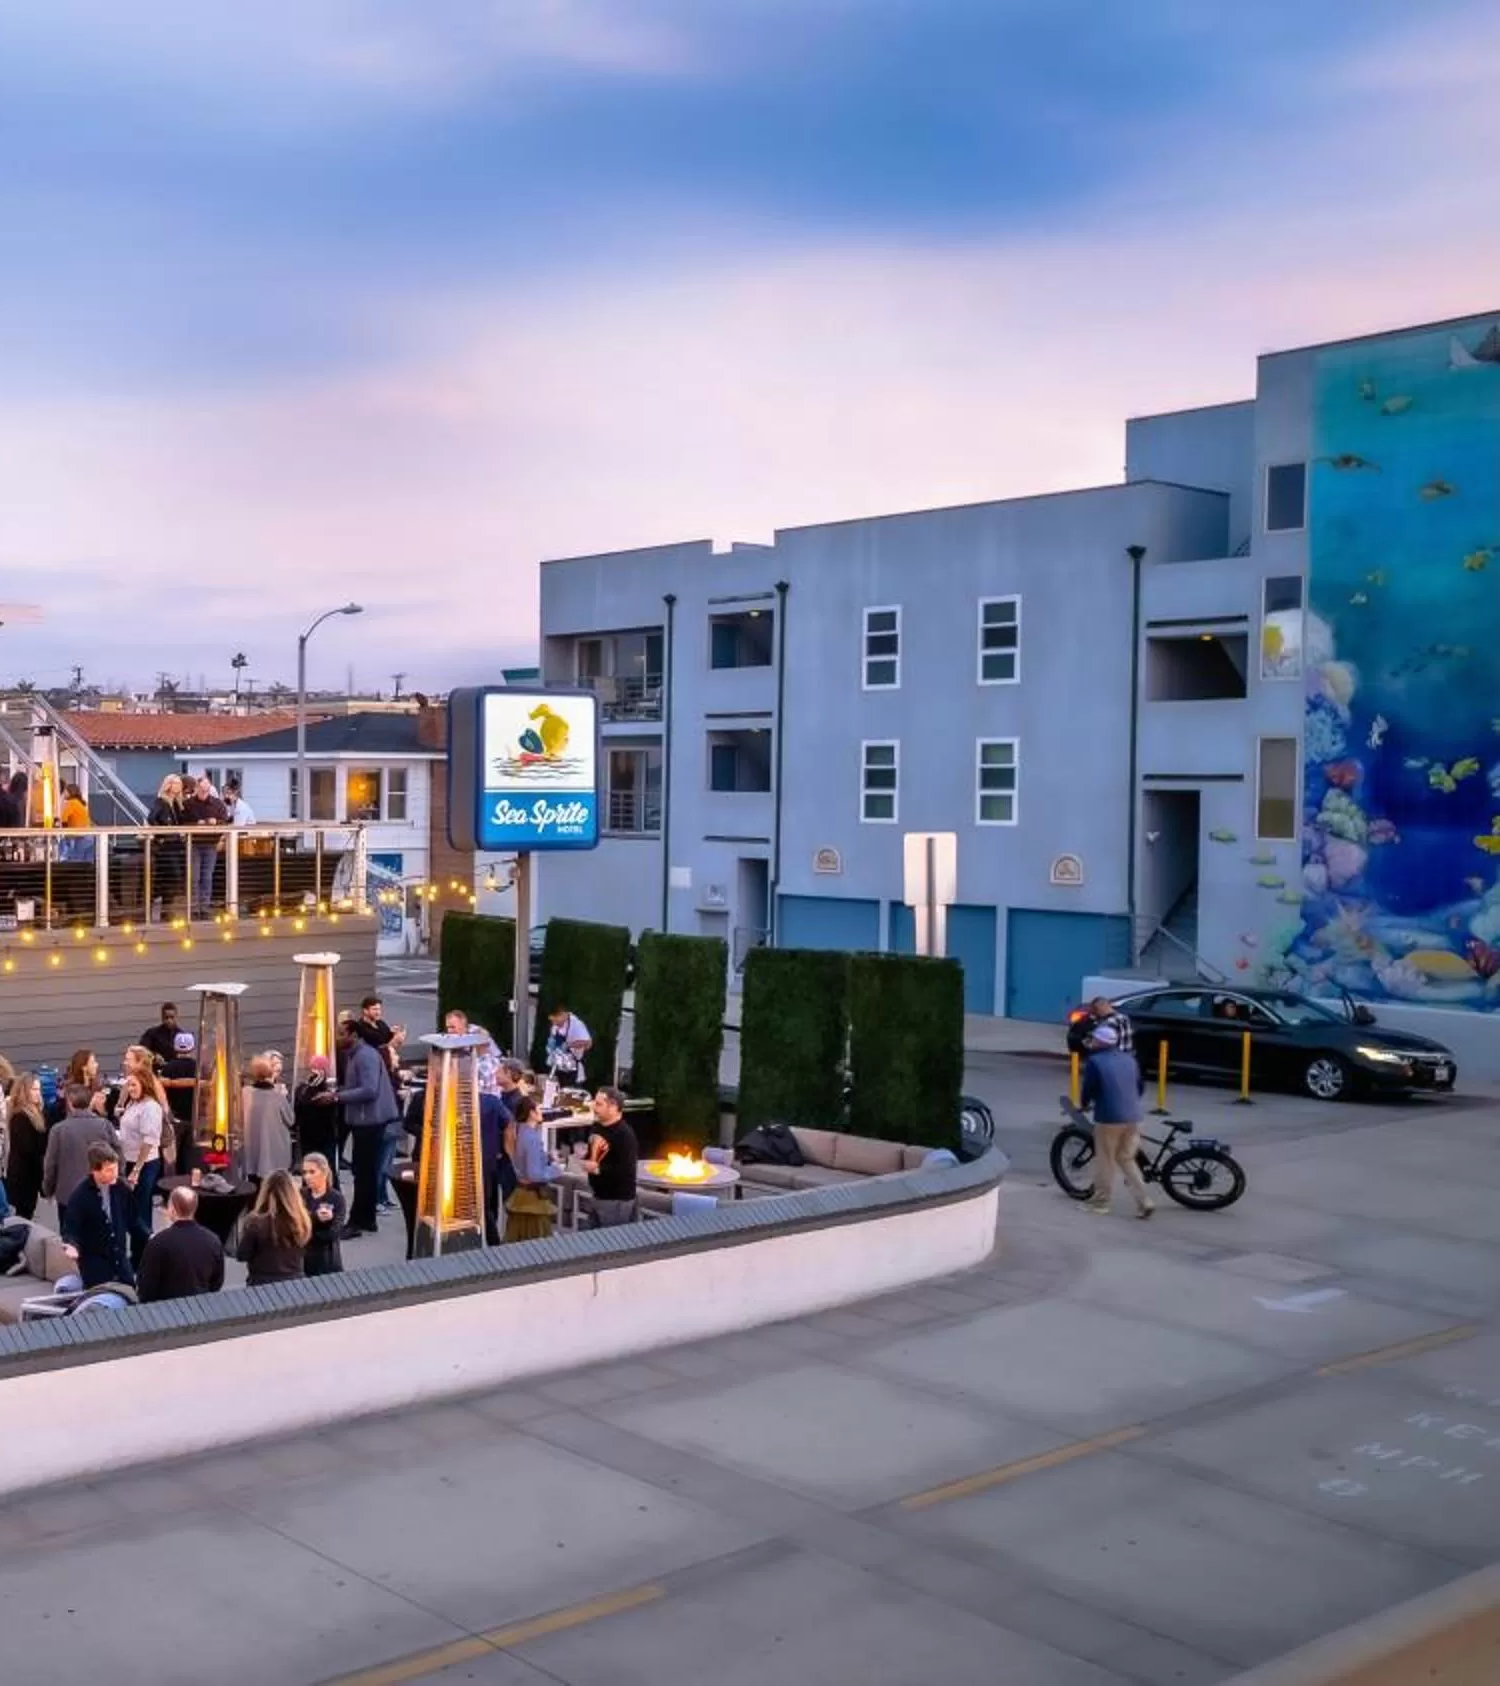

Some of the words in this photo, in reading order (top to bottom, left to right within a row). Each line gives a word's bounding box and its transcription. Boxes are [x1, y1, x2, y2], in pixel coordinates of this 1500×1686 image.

[491, 799, 528, 825] Sea
[529, 799, 589, 833] Sprite
[1352, 1441, 1485, 1485] MPH
